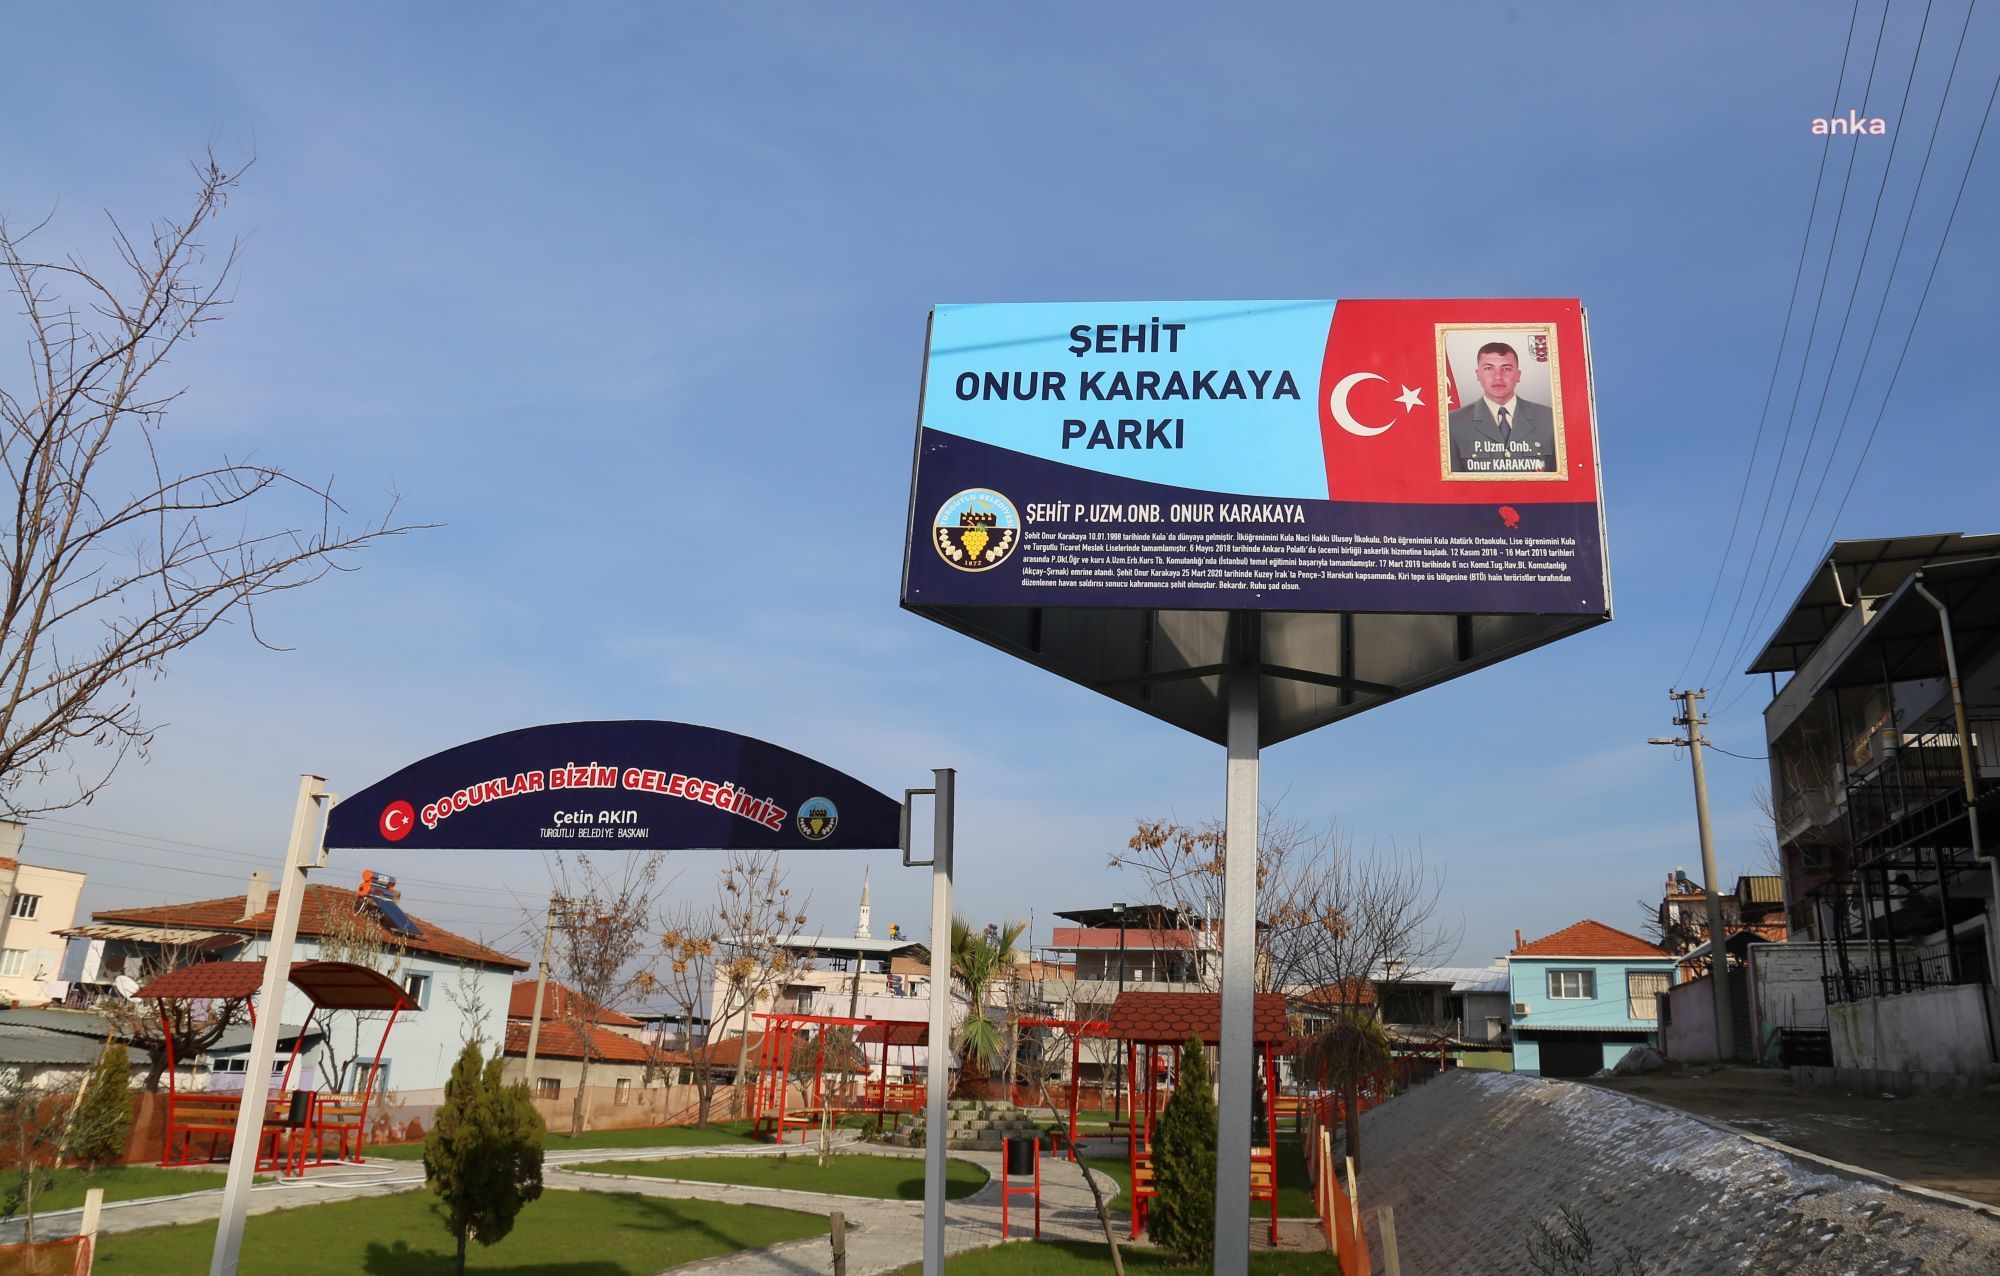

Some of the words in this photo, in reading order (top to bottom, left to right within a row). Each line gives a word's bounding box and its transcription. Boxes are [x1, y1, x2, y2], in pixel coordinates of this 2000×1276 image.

[1068, 316, 1186, 357] ŞEHİT
[955, 371, 1066, 401] ONUR
[1079, 370, 1301, 400] KARAKAYA
[1062, 418, 1184, 449] PARKI
[1474, 441, 1482, 452] P.
[1484, 441, 1508, 452] Uzm.
[1509, 440, 1532, 452] Onb.
[1467, 459, 1491, 470] Onur
[1492, 459, 1541, 470] KARAKAYA
[1026, 500, 1070, 523] ŞEHİT
[1074, 504, 1165, 523] P.UZM.ONB.
[1170, 504, 1214, 523] ONUR
[1219, 504, 1306, 524] KARAKAYA
[1025, 532, 1040, 540] Şehit
[1042, 532, 1056, 540] Onur
[1058, 532, 1086, 541] Karakaya
[1123, 533, 1150, 541] tarihinde
[1178, 534, 1203, 542] dünyaya
[1206, 534, 1235, 542] gelmiştir.
[1237, 532, 1278, 542] İlköğrenimini
[1296, 534, 1309, 542] Naci
[1312, 534, 1329, 542] Hakkı
[1331, 535, 1352, 543] Ulusoy
[1398, 536, 1432, 545] öğrenimini
[1525, 538, 1559, 547] öğrenimini
[1033, 543, 1057, 552] Turgutlu
[1106, 544, 1139, 552] Liselerinde
[1141, 545, 1188, 553] tamamlamıştır.
[1195, 545, 1214, 553] Mayıs
[1341, 547, 1362, 556] birliği)
[1424, 548, 1448, 556] başladı.
[1549, 549, 1574, 557] tarihleri
[1269, 558, 1296, 567] eğitimini
[1299, 559, 1327, 568] başarıyla
[1329, 559, 1377, 568] tamamlamıştır.
[1529, 561, 1567, 571] Komutanlığı
[1151, 569, 1180, 578] Karakaya
[1254, 570, 1272, 579] Kuzey
[1411, 574, 1425, 582] tepe
[1437, 574, 1467, 582] bölgesine
[1470, 572, 1486, 582] (BTÖ)
[1130, 580, 1168, 588] kahramanca
[421, 771, 544, 829] ÇOCUKLAR
[550, 762, 618, 790] BİZİM
[622, 768, 787, 832] GELECEĞİMİZ
[553, 810, 593, 827] Çetin
[540, 828, 574, 837] TURGUTLU
[578, 828, 614, 837] BELEDİYE
[617, 828, 649, 838] BAŞKANI
